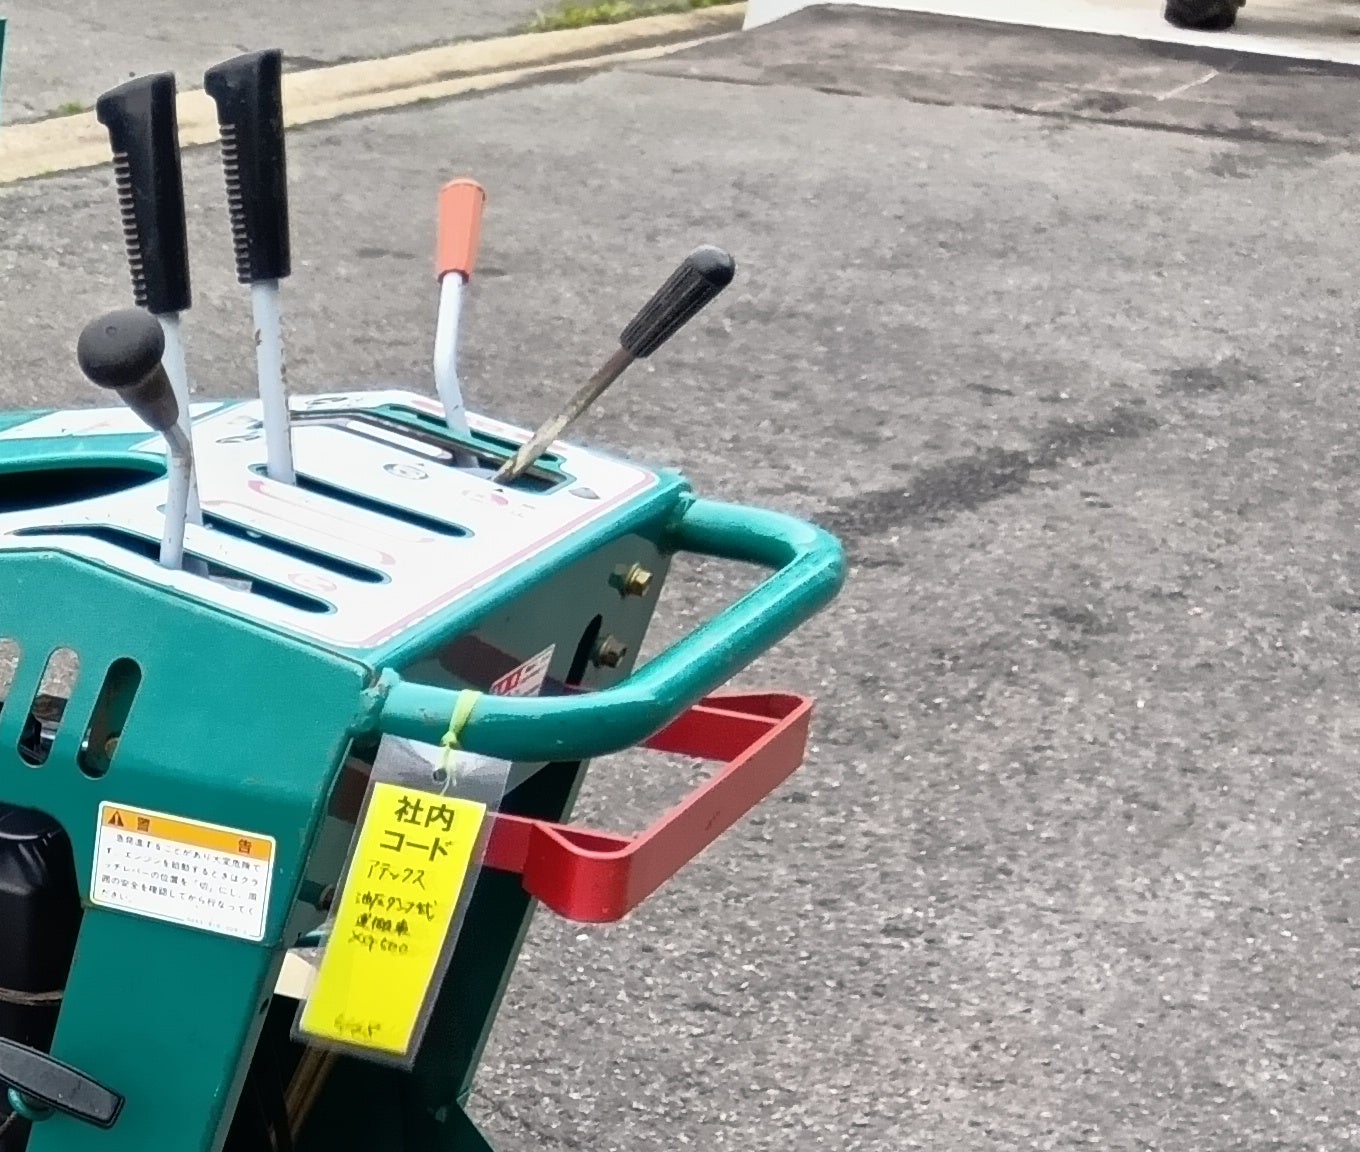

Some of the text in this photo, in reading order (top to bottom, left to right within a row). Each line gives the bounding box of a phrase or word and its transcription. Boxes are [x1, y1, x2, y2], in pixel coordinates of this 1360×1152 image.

[395, 795, 455, 832] 社内
[380, 829, 453, 862] コード
